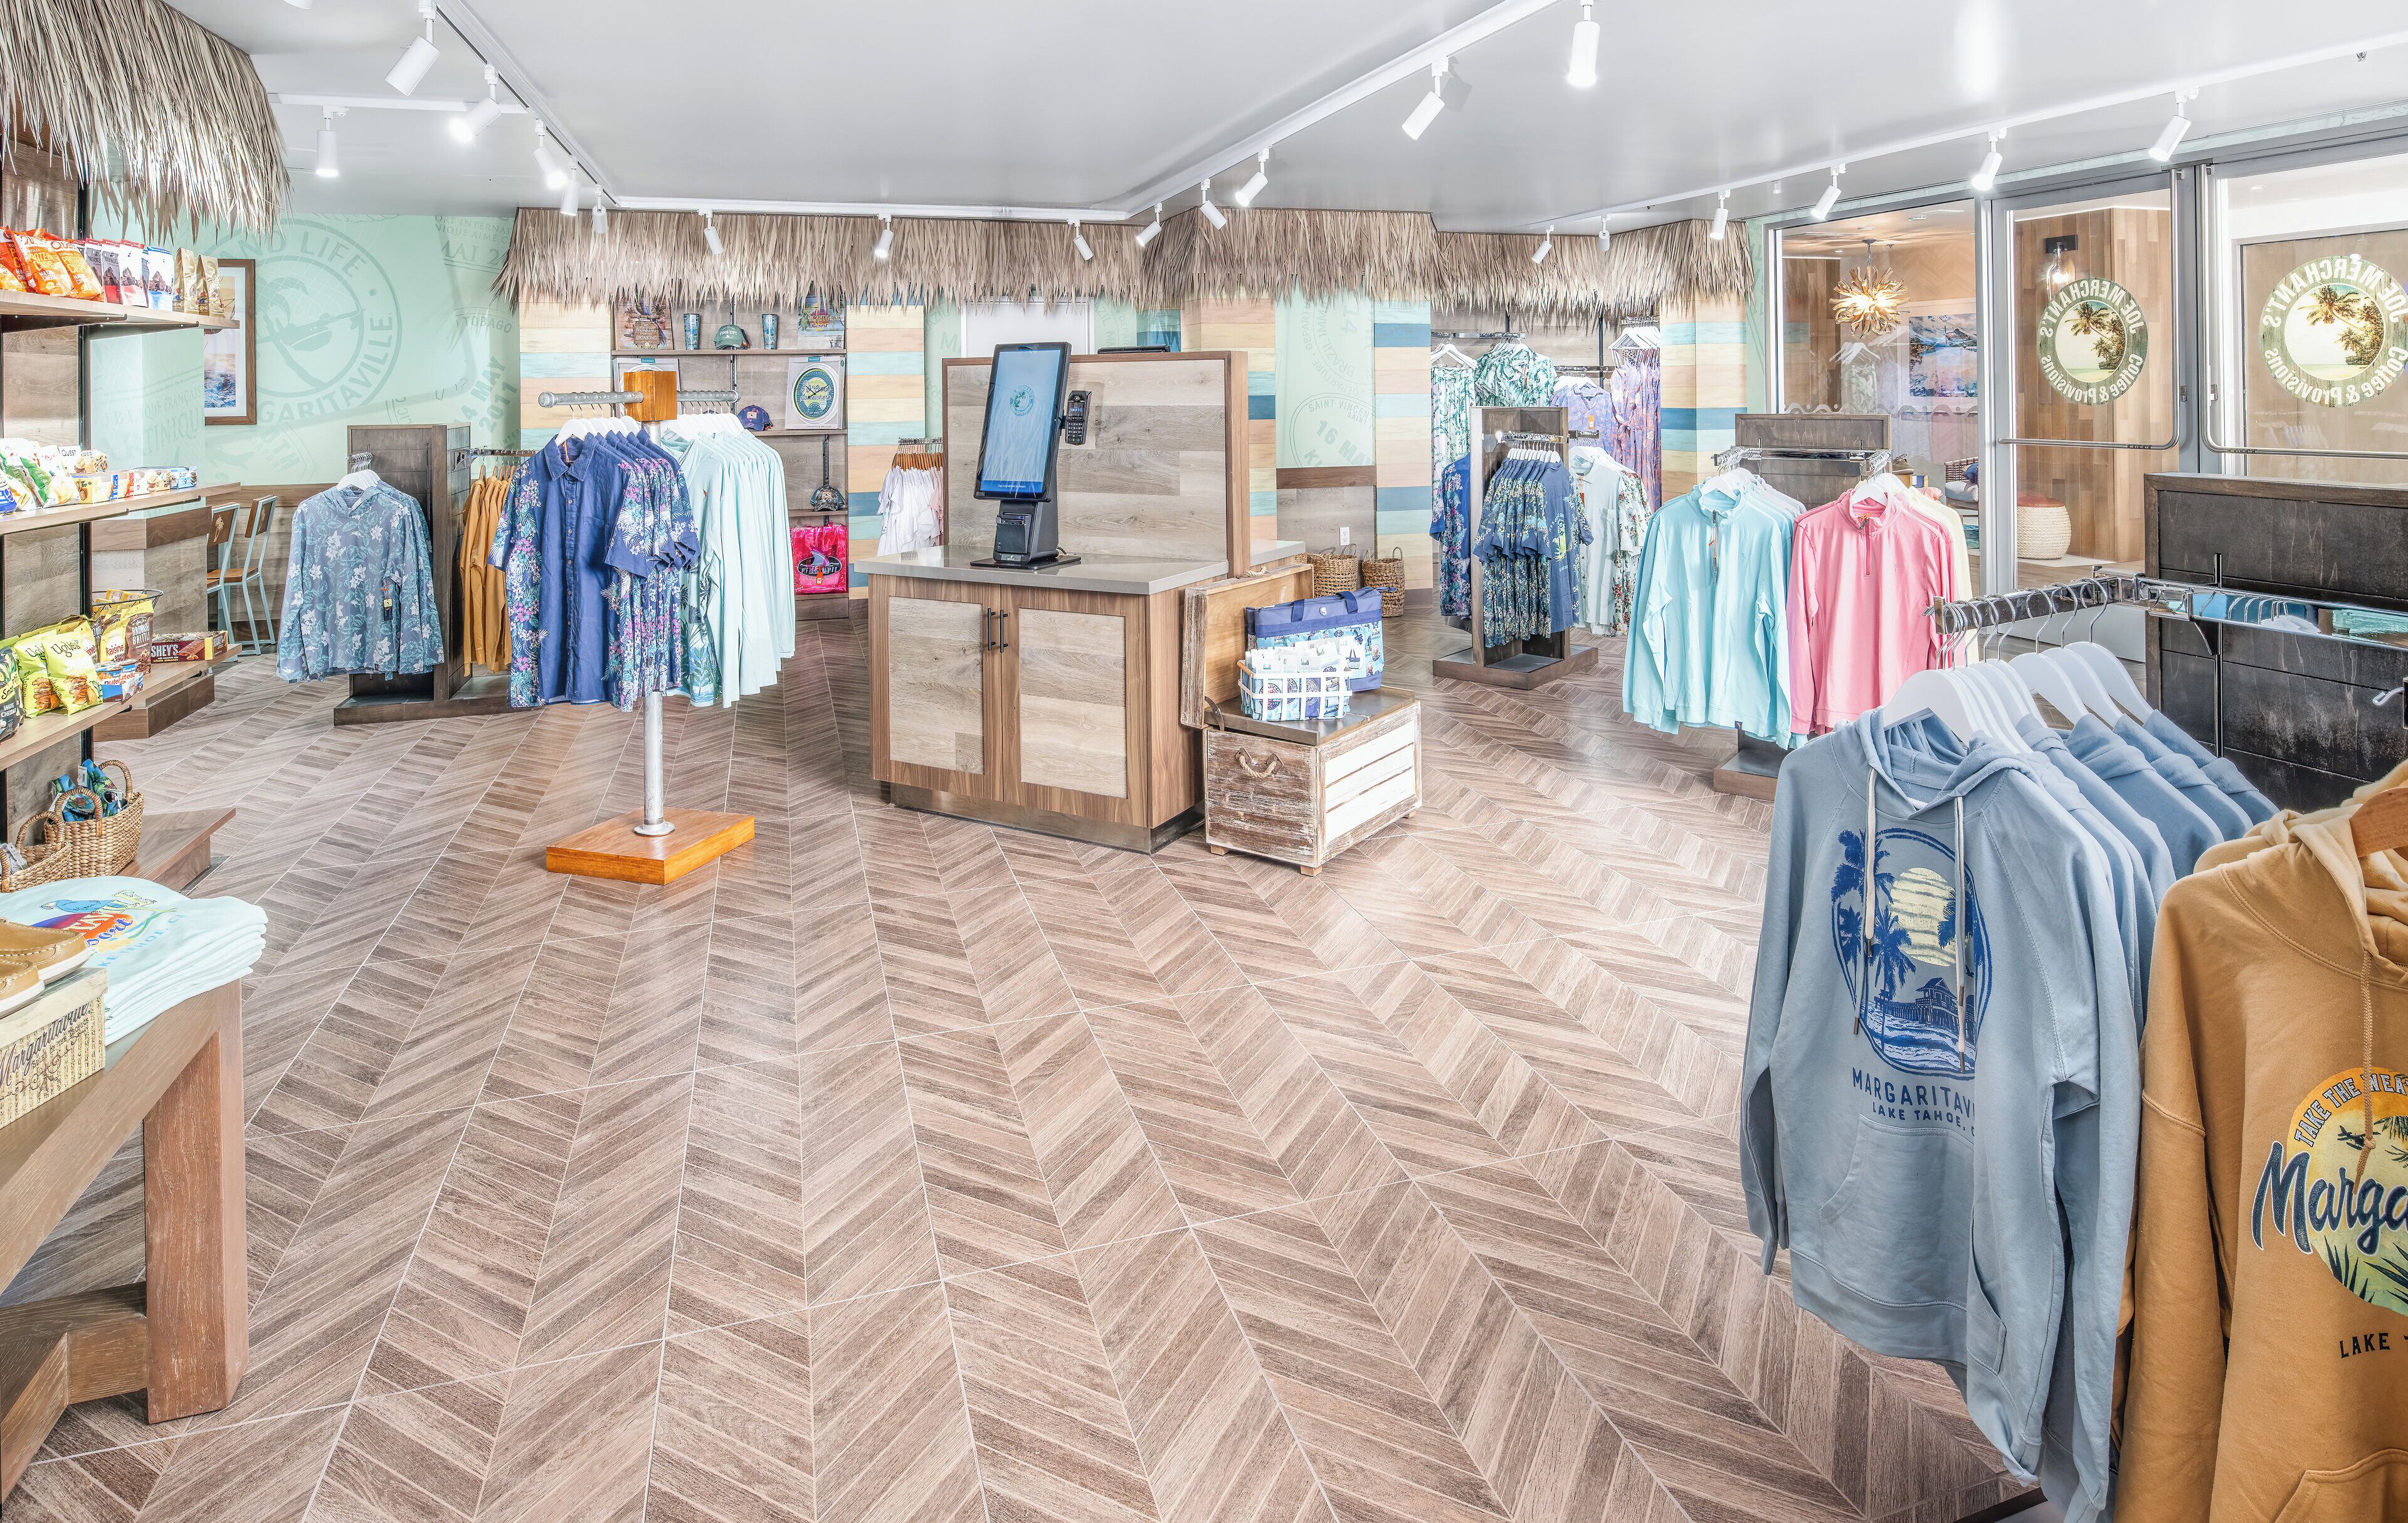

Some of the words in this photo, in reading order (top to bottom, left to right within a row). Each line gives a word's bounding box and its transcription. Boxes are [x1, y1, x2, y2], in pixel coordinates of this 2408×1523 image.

[301, 230, 367, 278] LIFE
[258, 316, 393, 423] GARITAVILLE
[470, 356, 505, 401] MAY
[479, 381, 518, 433] 2011
[1309, 399, 1334, 412] SAINT
[1317, 420, 1338, 445] 16
[51, 640, 80, 657] Uglies
[151, 644, 178, 657] SHEY'S
[1872, 1101, 1906, 1120] LAKE
[2294, 1100, 2331, 1147] TAKE
[2322, 1078, 2362, 1108] THE
[2340, 1332, 2390, 1359] LAKE
